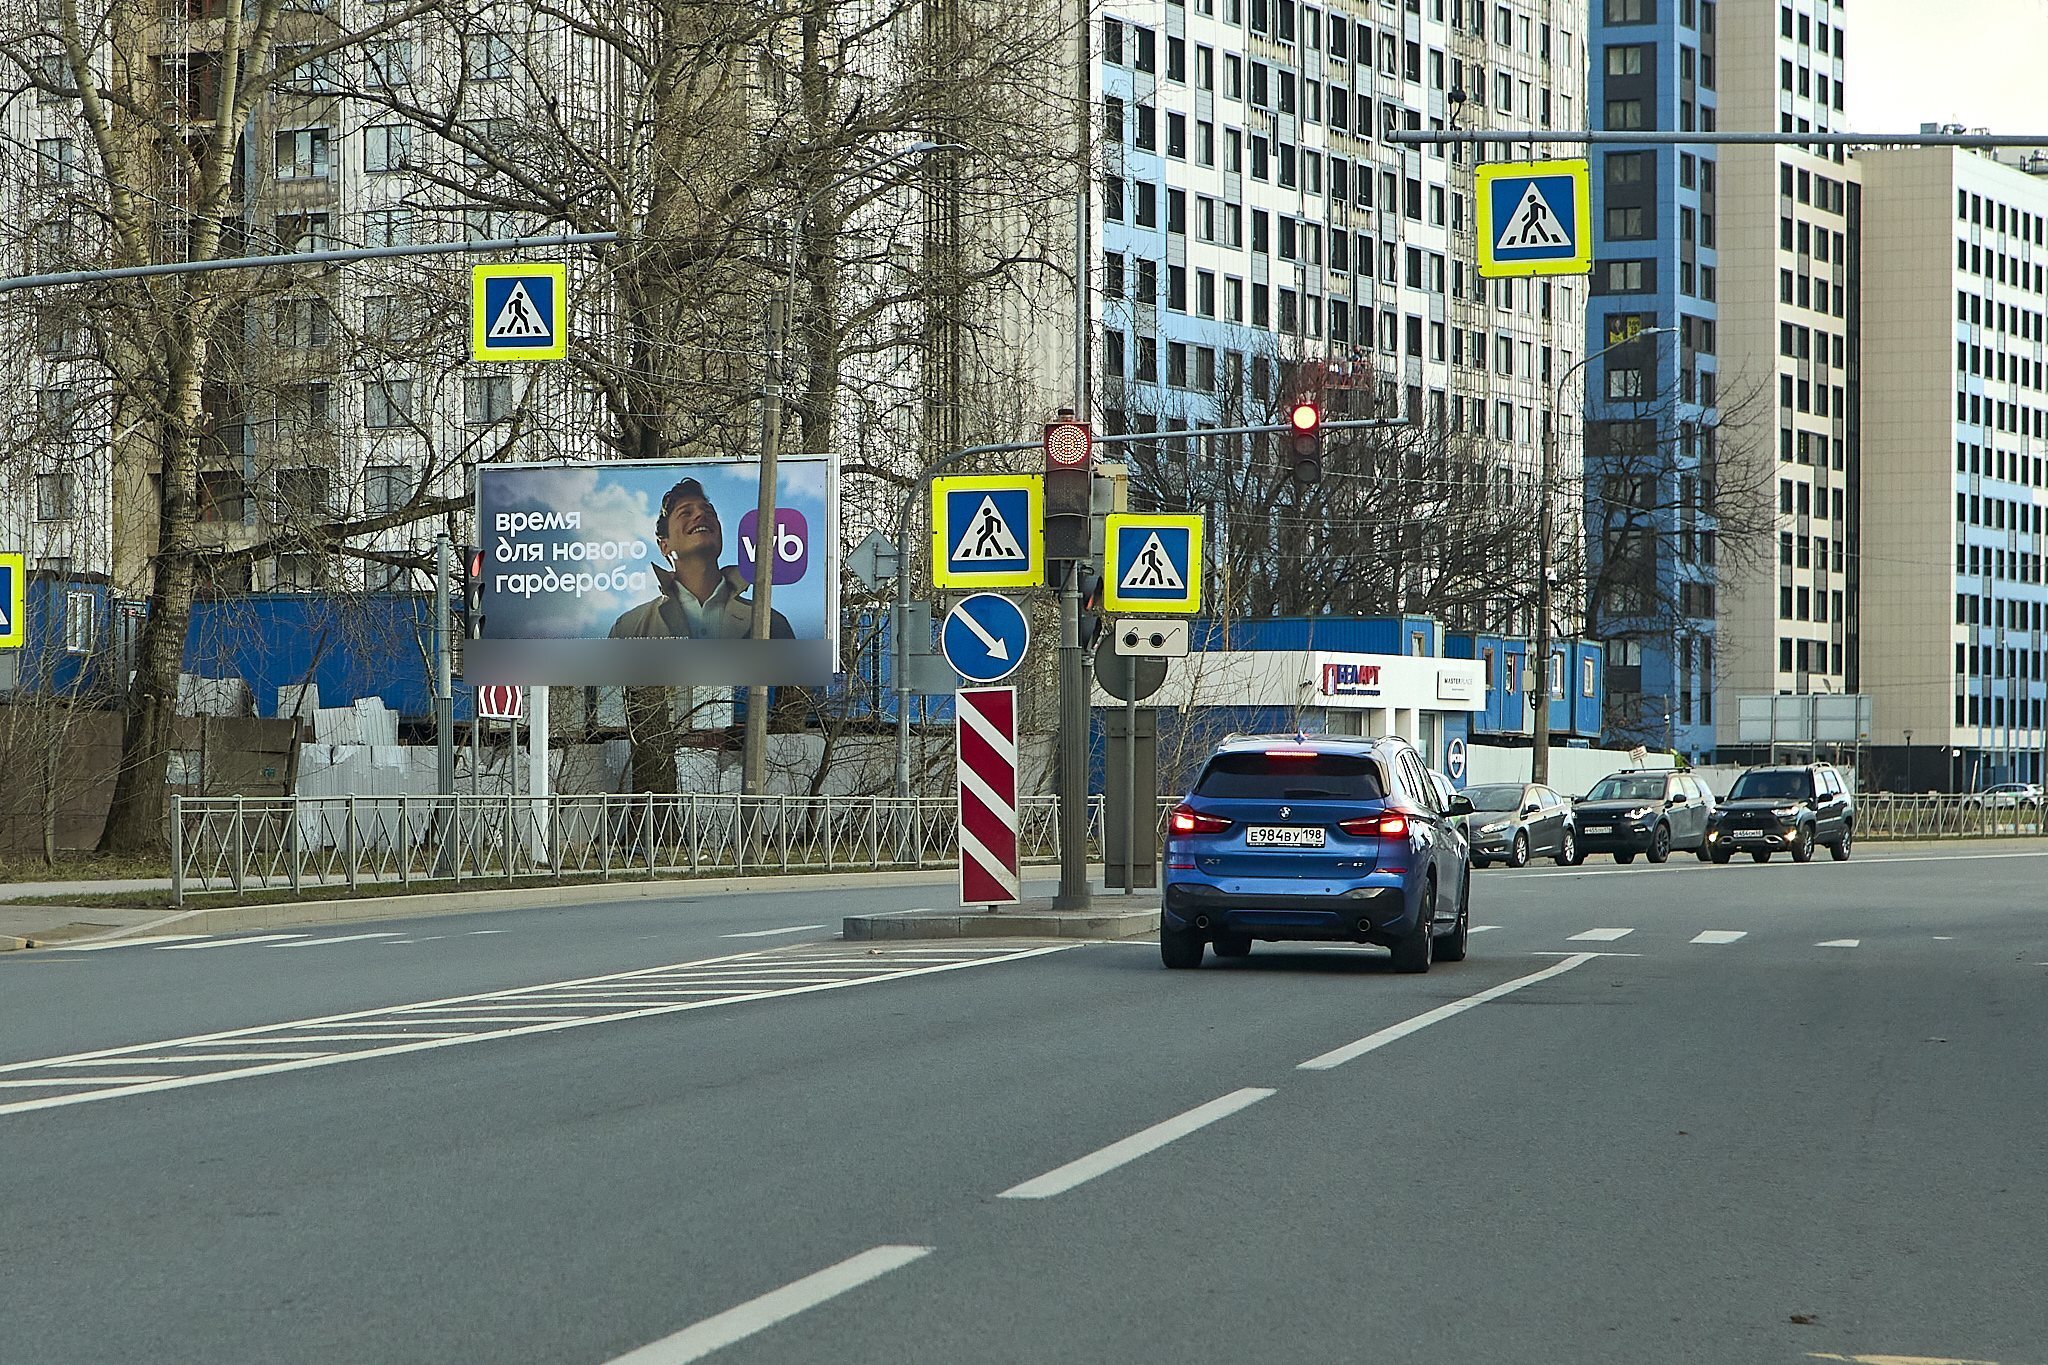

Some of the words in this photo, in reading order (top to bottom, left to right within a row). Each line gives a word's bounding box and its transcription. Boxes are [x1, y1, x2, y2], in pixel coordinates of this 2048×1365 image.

[495, 511, 581, 538] время
[495, 537, 544, 563] для
[552, 541, 648, 561] нового
[496, 565, 646, 599] гардероба
[1302, 829, 1322, 840] 198
